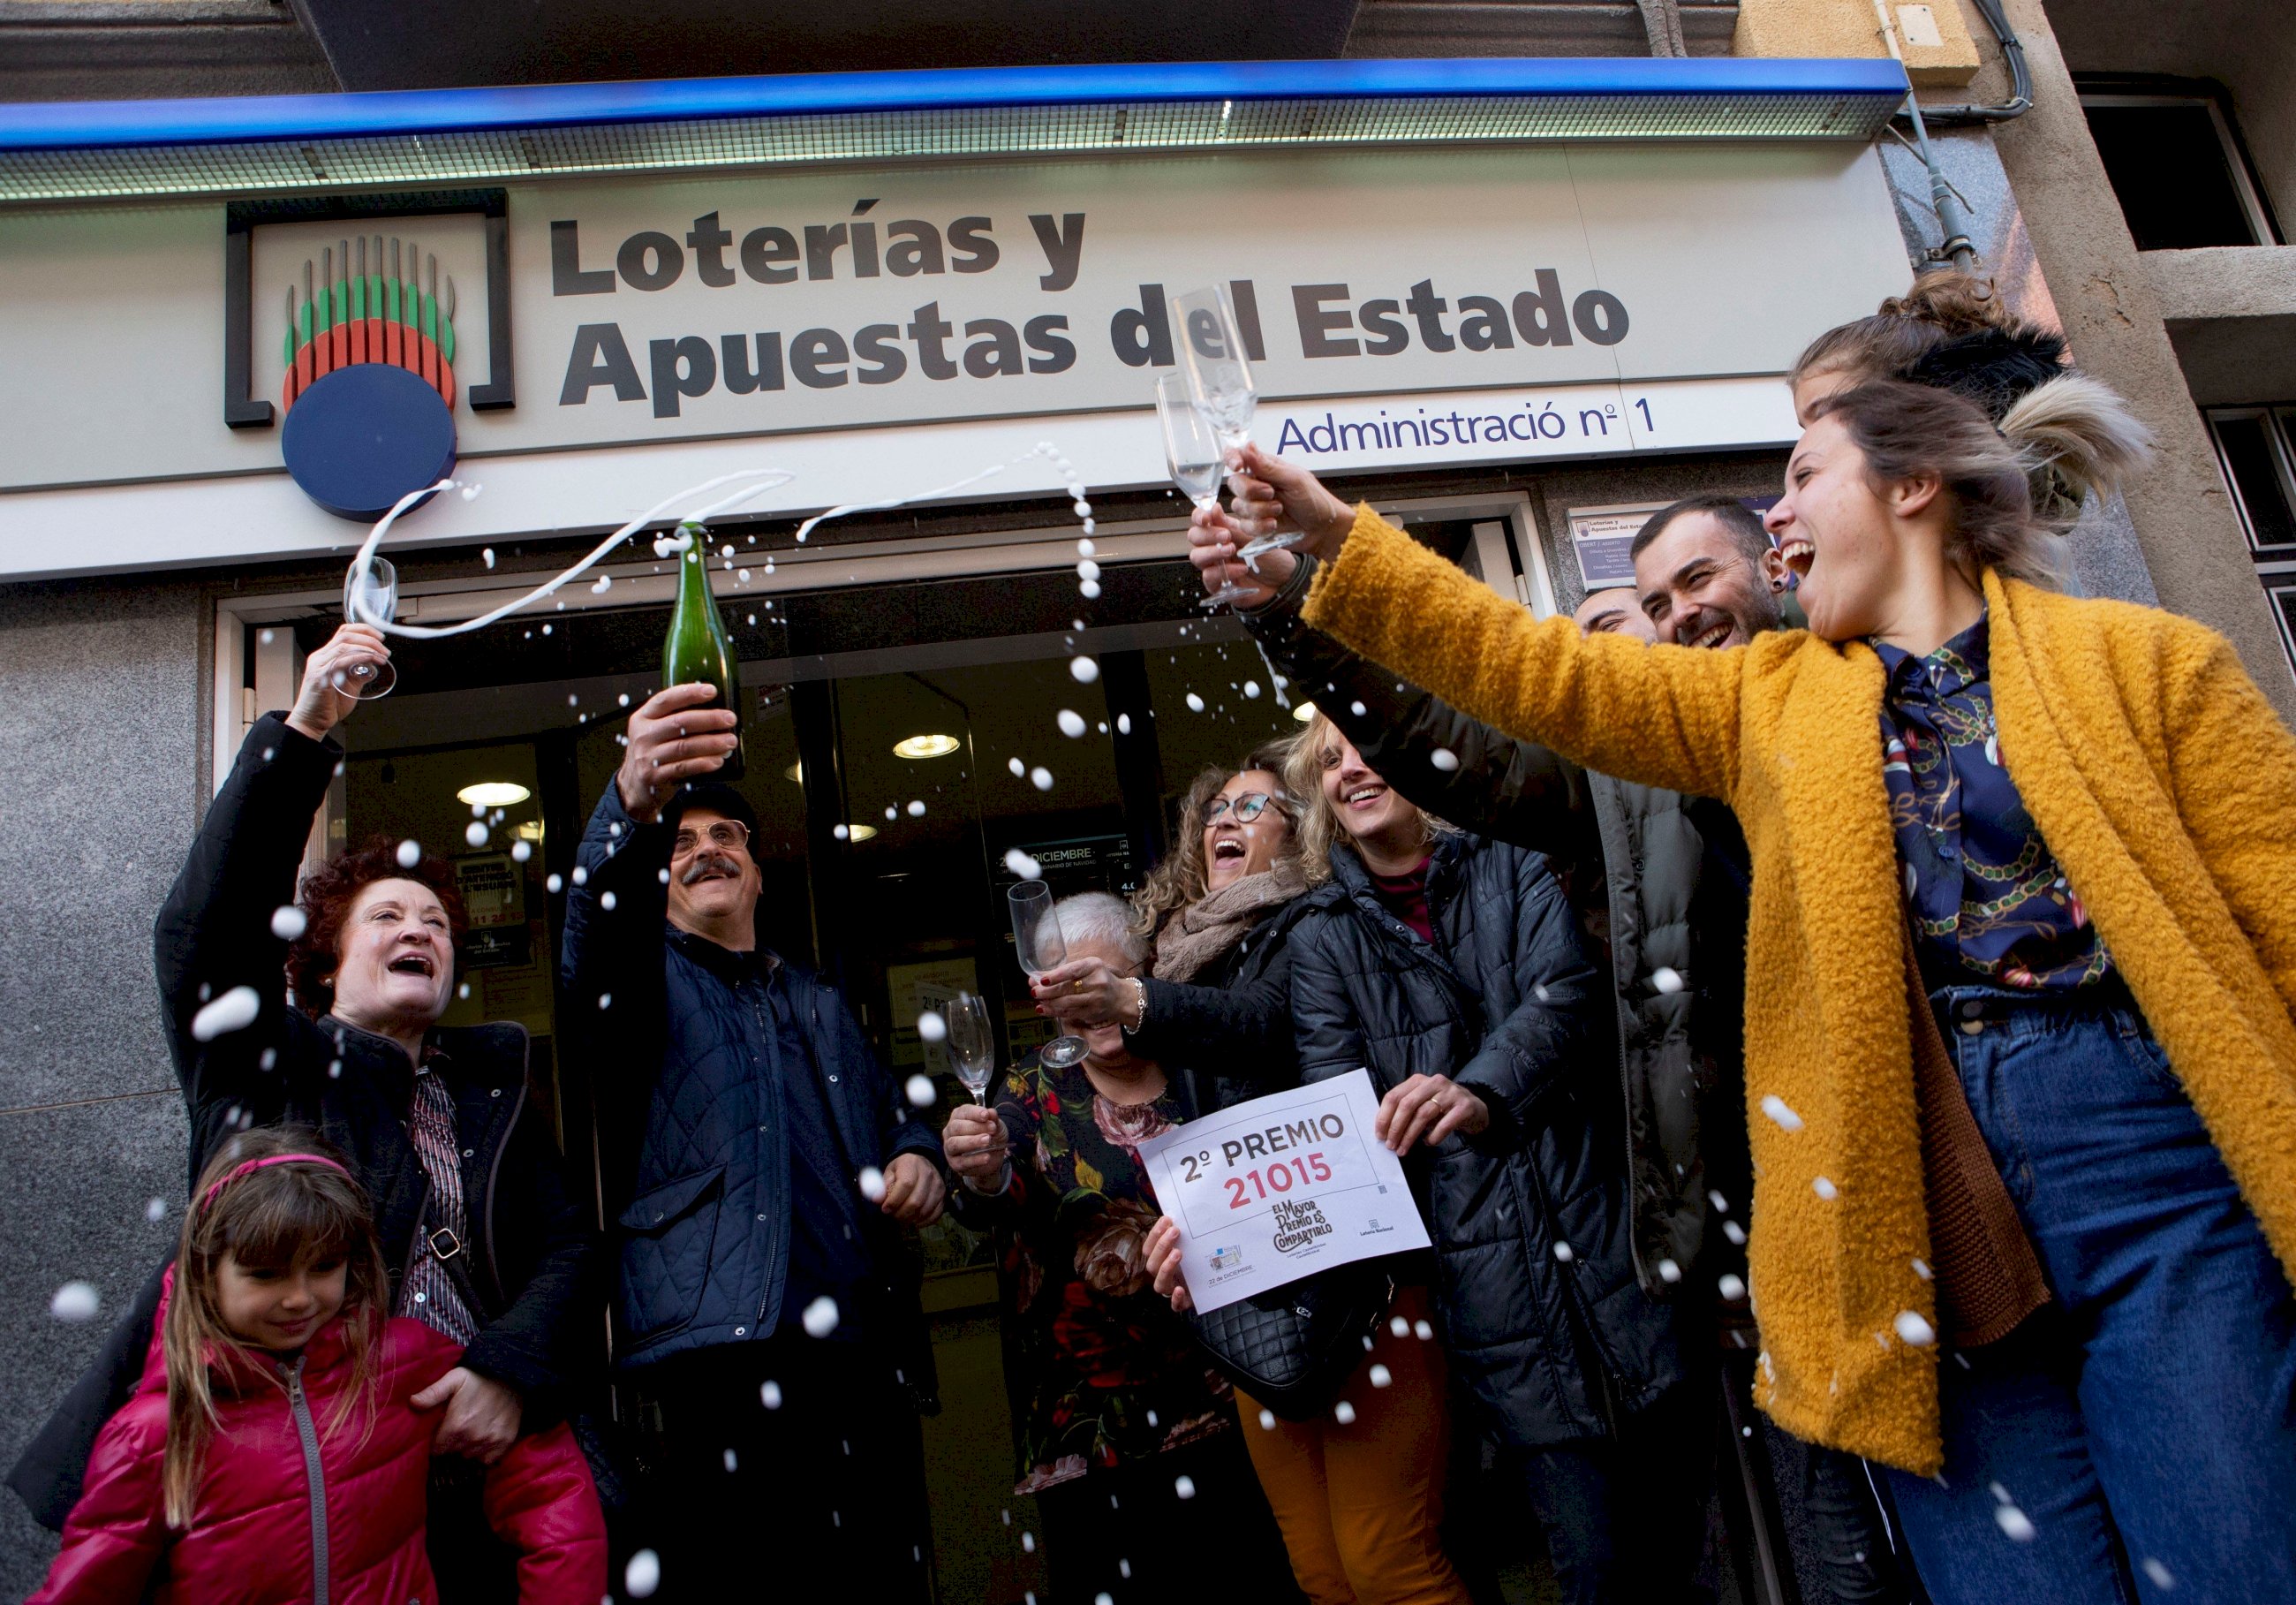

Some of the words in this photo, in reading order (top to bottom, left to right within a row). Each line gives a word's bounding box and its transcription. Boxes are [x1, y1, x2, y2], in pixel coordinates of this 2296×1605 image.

[549, 198, 1001, 297] Loterías
[1026, 211, 1087, 292] y
[558, 299, 1077, 419] Apuestas
[1109, 279, 1266, 367] del
[1290, 268, 1630, 360] Estado
[1276, 401, 1566, 456] Administració
[1634, 397, 1656, 433] 1
[1031, 847, 1092, 864] DICIEMBRE
[1179, 1150, 1212, 1184] 2º
[1220, 1113, 1345, 1168] PREMIO
[1223, 1152, 1333, 1210] 21015
[1272, 1203, 1283, 1215] EL
[1281, 1200, 1318, 1221] MAYOR
[1275, 1214, 1313, 1236] PREMIO
[1312, 1209, 1326, 1224] ES
[1273, 1223, 1333, 1253] COMPARTIRLO
[1223, 1264, 1254, 1280] DICIEMBRE
